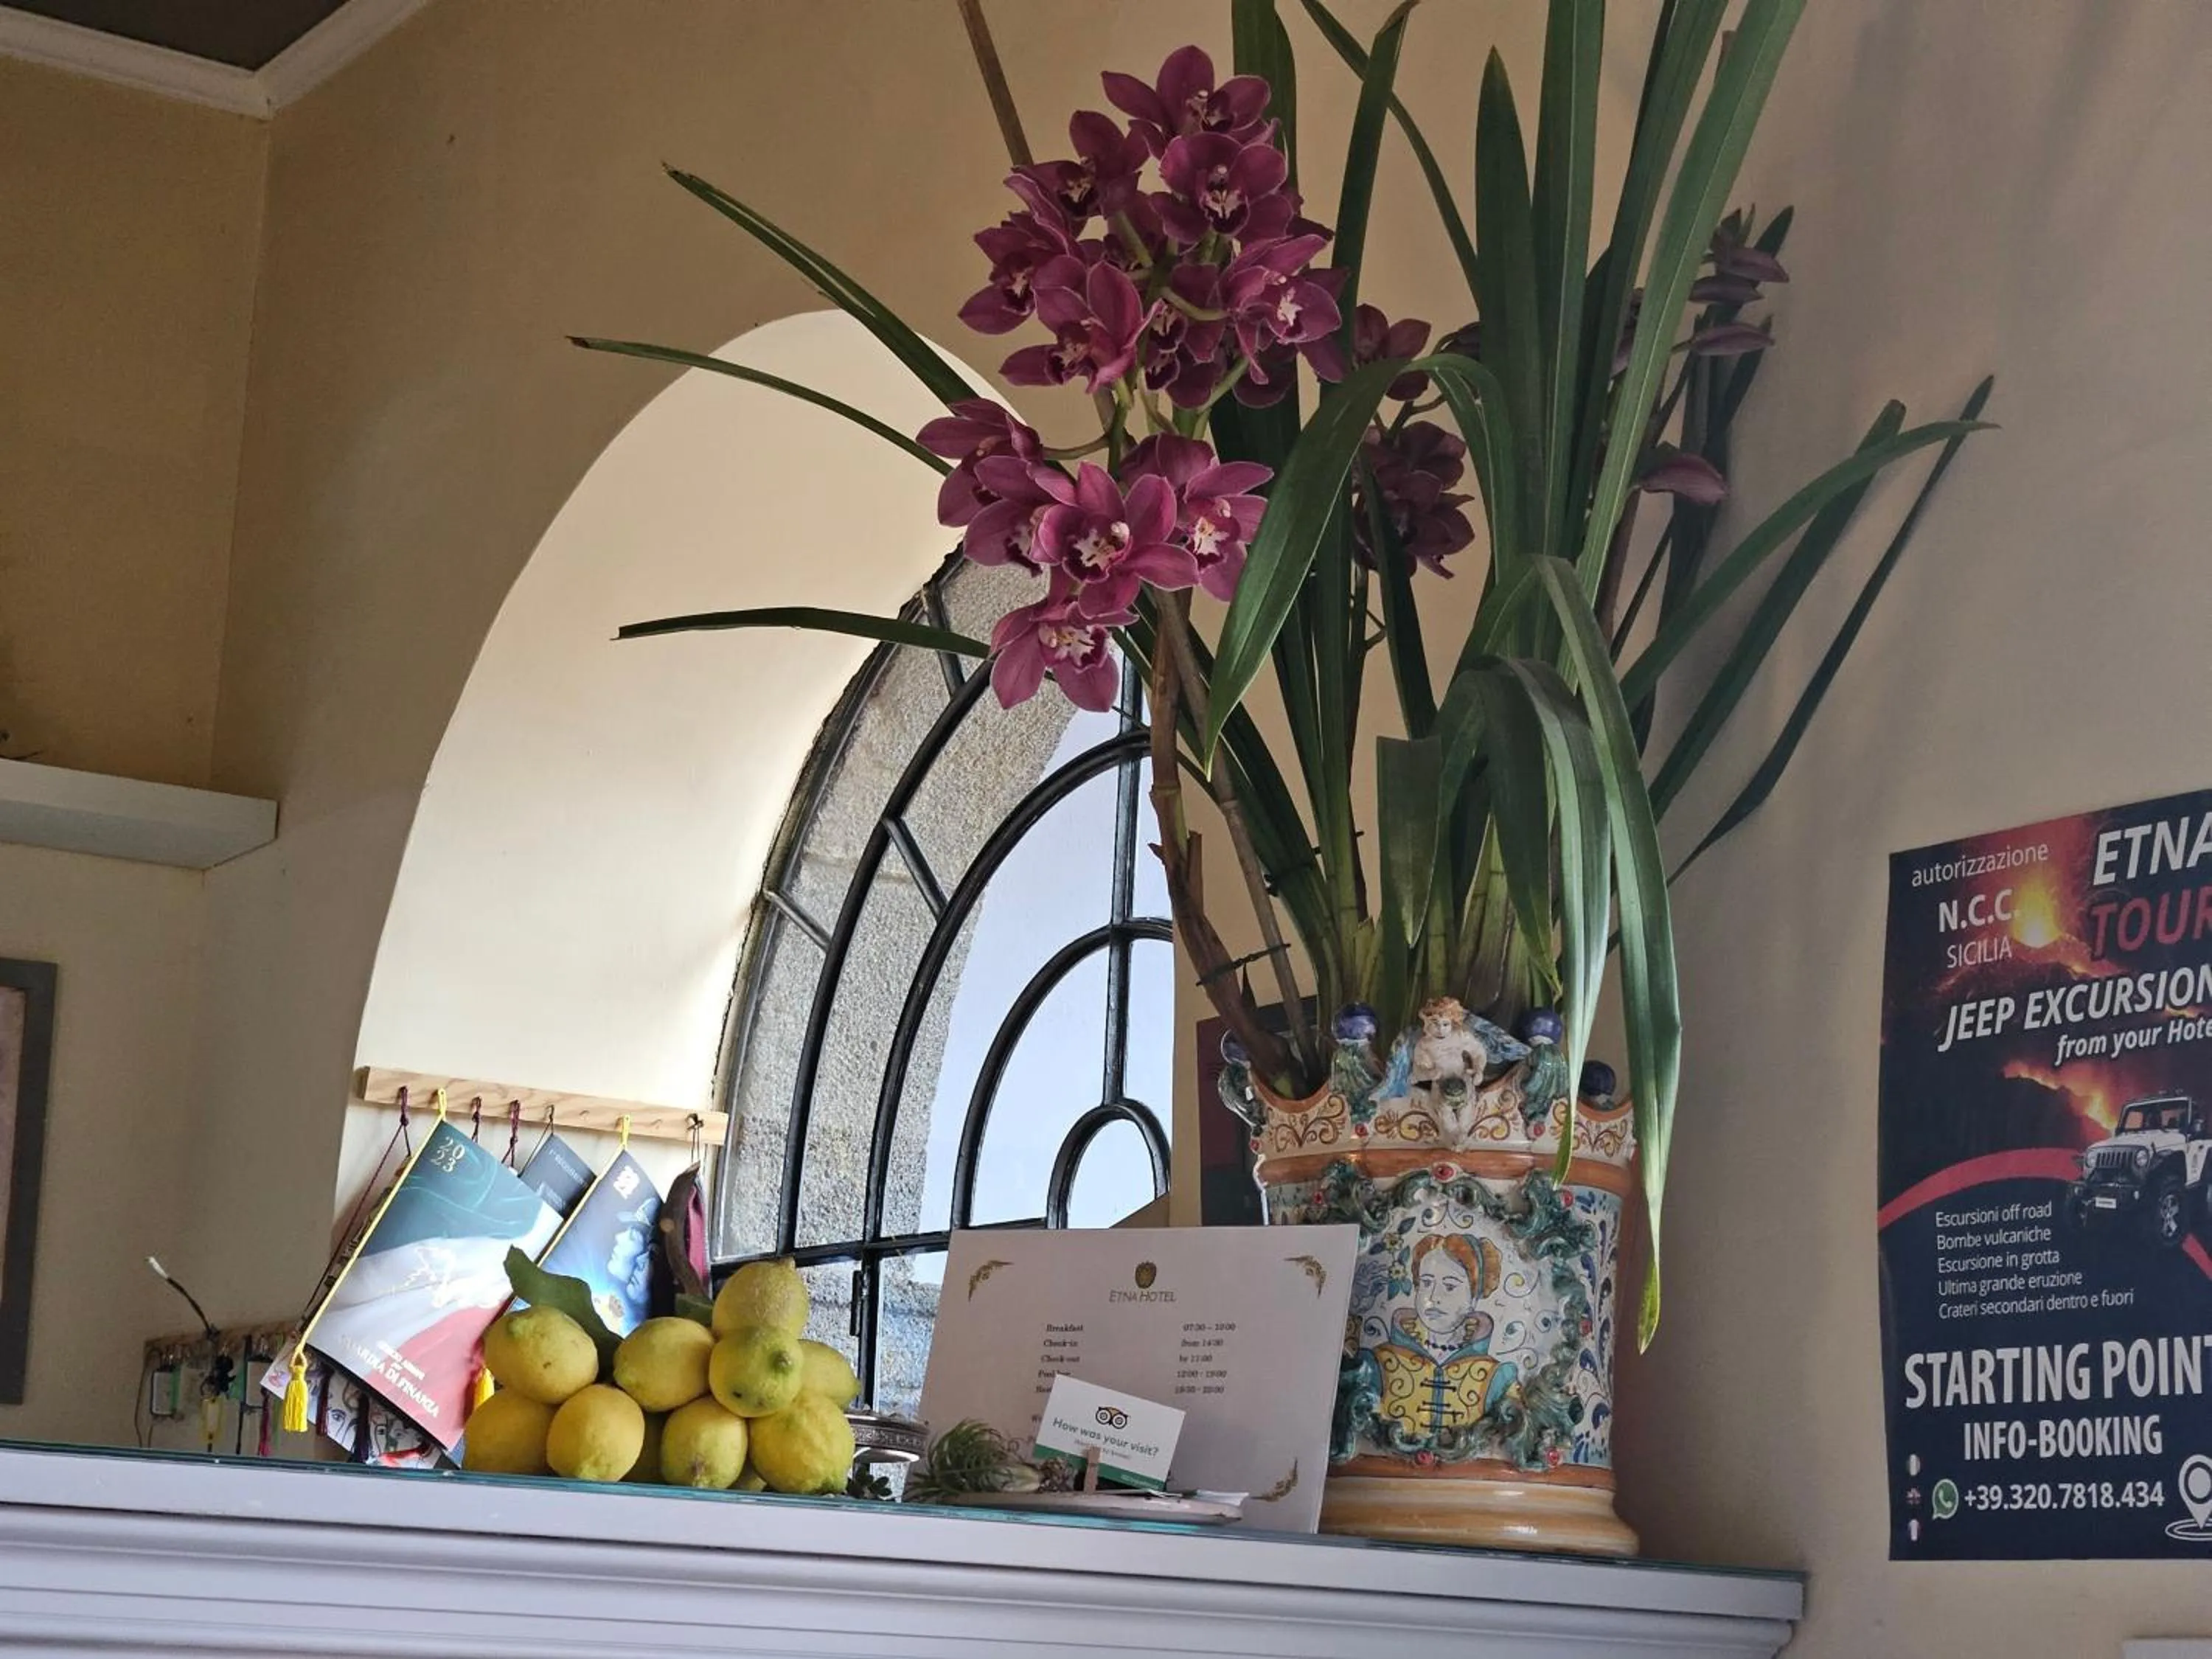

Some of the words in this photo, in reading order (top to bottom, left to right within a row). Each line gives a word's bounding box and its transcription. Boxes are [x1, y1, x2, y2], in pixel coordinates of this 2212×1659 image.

[1912, 843, 2049, 887] autorizzazione
[2093, 812, 2212, 886] ETNA
[1947, 936, 2012, 968] SICILIA
[1938, 998, 2015, 1052] JEEP
[2024, 963, 2212, 1030] EXCURSION
[2054, 1033, 2107, 1066] from
[2111, 1026, 2163, 1059] your
[1935, 1206, 1999, 1228] Escursioni
[2002, 1202, 2020, 1222] off
[2023, 1201, 2052, 1219] road
[1937, 1234, 1982, 1251] Bombe
[1983, 1227, 2051, 1246] vulcaniche
[1938, 1253, 2003, 1273] Escursione
[2006, 1251, 2019, 1268] in
[2021, 1248, 2060, 1270] grotta
[1109, 1290, 1138, 1303] ETNA
[1139, 1290, 1178, 1303] HOTEL
[1938, 1278, 1977, 1296] Ultima
[1979, 1273, 2025, 1297] grande
[2028, 1270, 2083, 1290] eruzione
[1938, 1300, 1978, 1320] Crateri
[1981, 1293, 2043, 1314] secondari
[2046, 1292, 2088, 1311] dentro
[2090, 1294, 2099, 1308] e
[2101, 1288, 2135, 1307] fuori
[1905, 1343, 2091, 1409] STARTING
[1052, 1417, 1079, 1433] How
[1080, 1427, 1102, 1440] was
[1103, 1436, 1129, 1447] your
[1130, 1441, 1160, 1458] visit?
[1964, 1414, 2163, 1461] INFO-BOOKING
[1964, 1481, 2166, 1511] +39.320.7818.434
